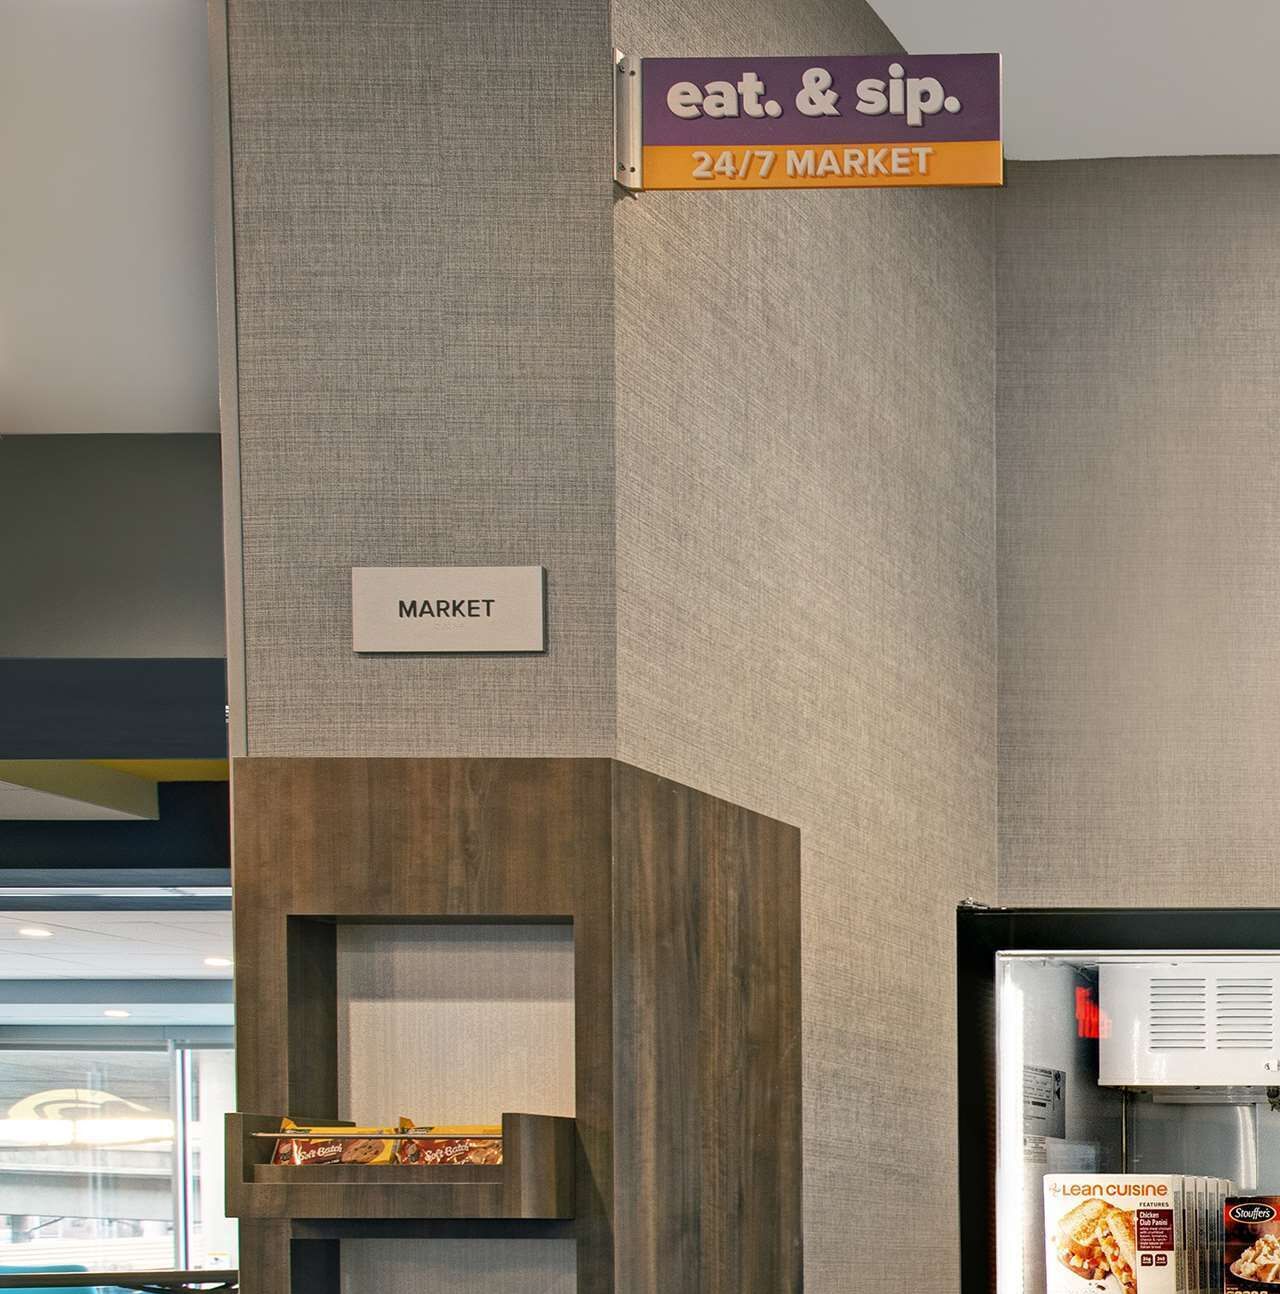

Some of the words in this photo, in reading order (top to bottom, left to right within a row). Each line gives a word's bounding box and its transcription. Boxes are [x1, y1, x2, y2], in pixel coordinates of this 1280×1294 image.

[667, 72, 783, 118] eat.
[795, 67, 840, 117] &
[856, 63, 961, 127] sip.
[692, 149, 778, 179] 24/7
[786, 147, 934, 177] MARKET
[398, 599, 496, 618] MARKET
[298, 1148, 316, 1161] Soft
